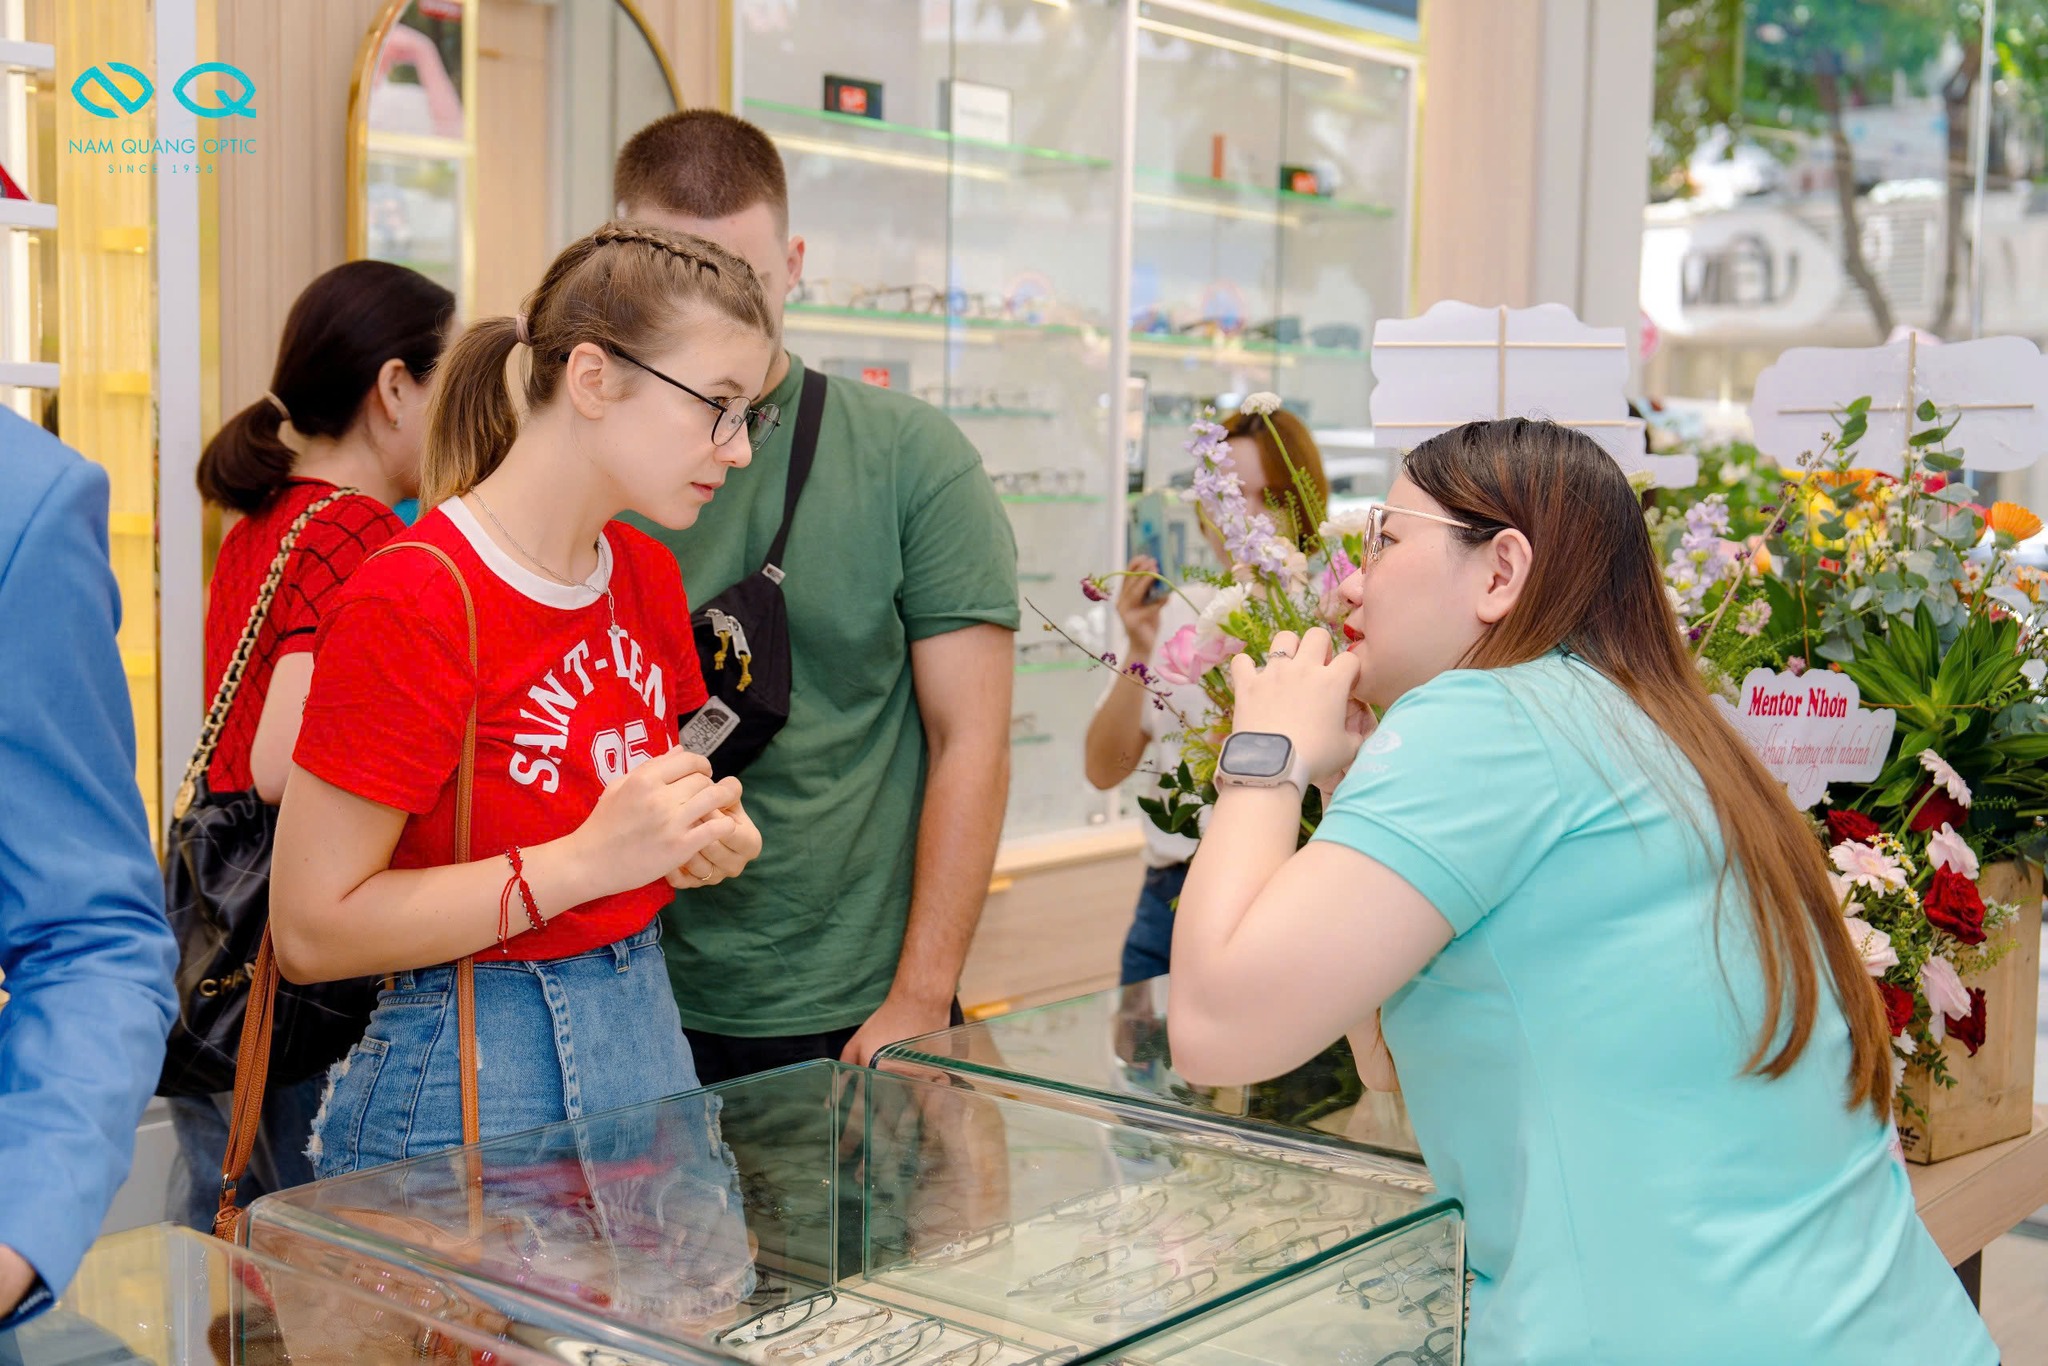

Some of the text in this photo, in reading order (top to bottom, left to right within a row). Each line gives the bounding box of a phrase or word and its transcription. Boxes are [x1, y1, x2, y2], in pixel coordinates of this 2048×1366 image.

[1748, 686, 1848, 718] Mentor Nhơn
[684, 721, 712, 750] NORTH
[690, 715, 707, 732] THE
[697, 727, 718, 749] FACE
